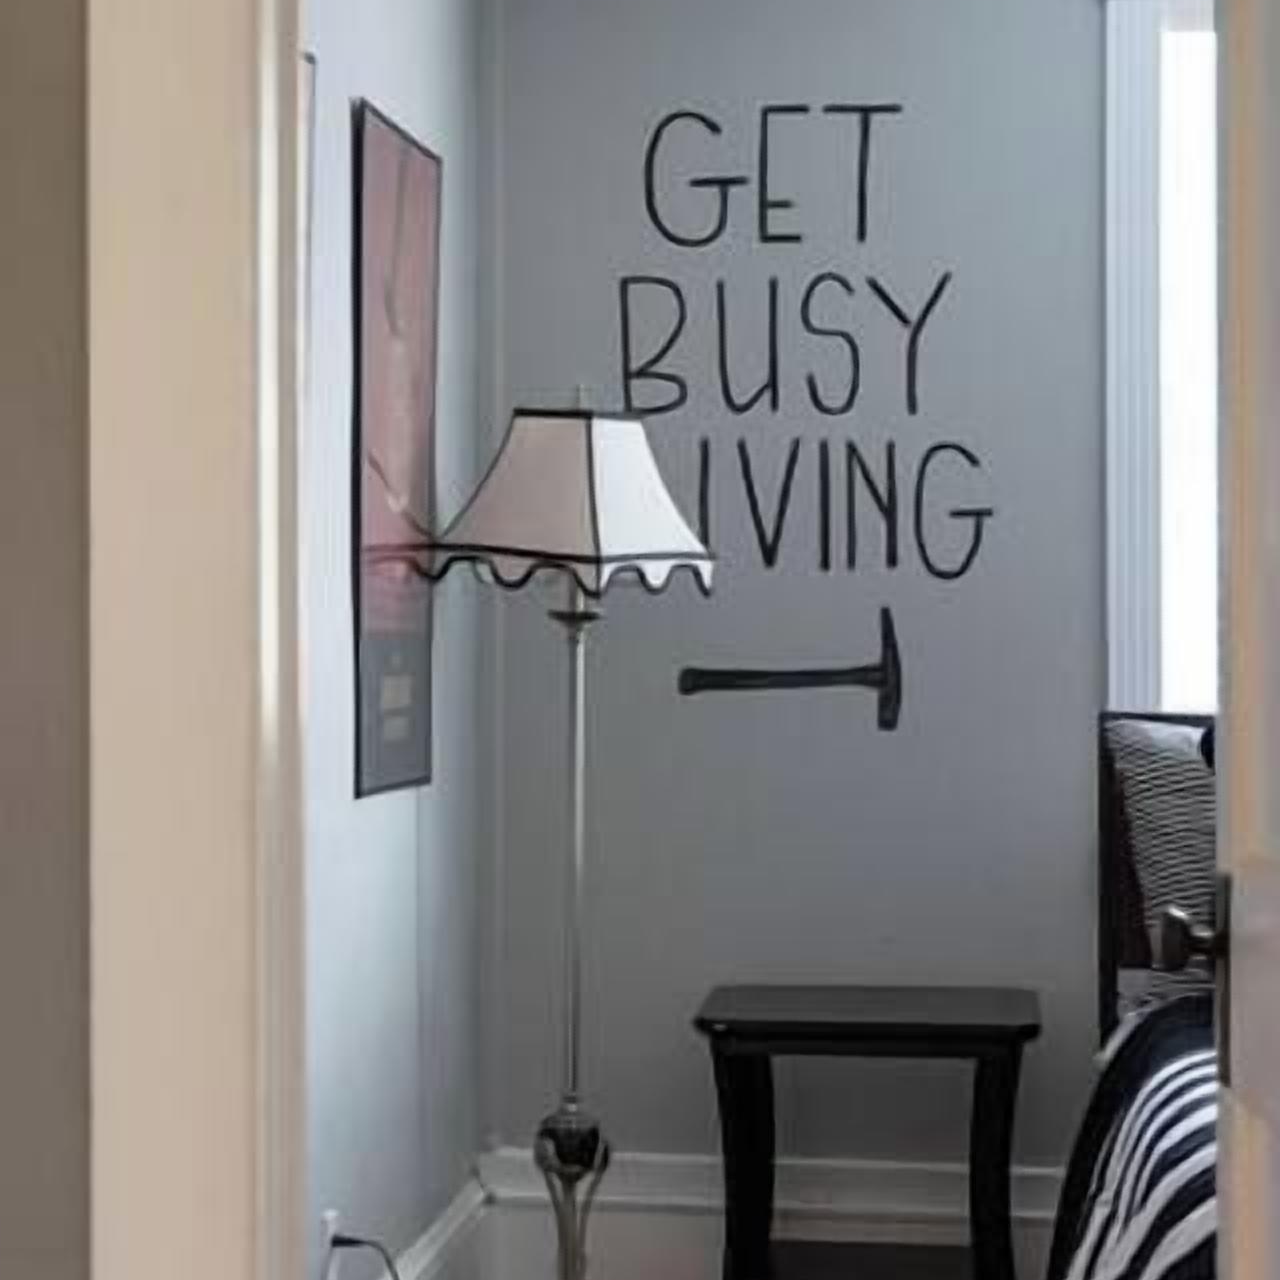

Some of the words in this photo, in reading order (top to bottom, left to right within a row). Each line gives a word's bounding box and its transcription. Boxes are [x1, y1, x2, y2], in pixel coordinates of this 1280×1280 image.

[644, 102, 904, 248] GET
[619, 270, 953, 418] BUSY
[698, 436, 994, 581] IVING
